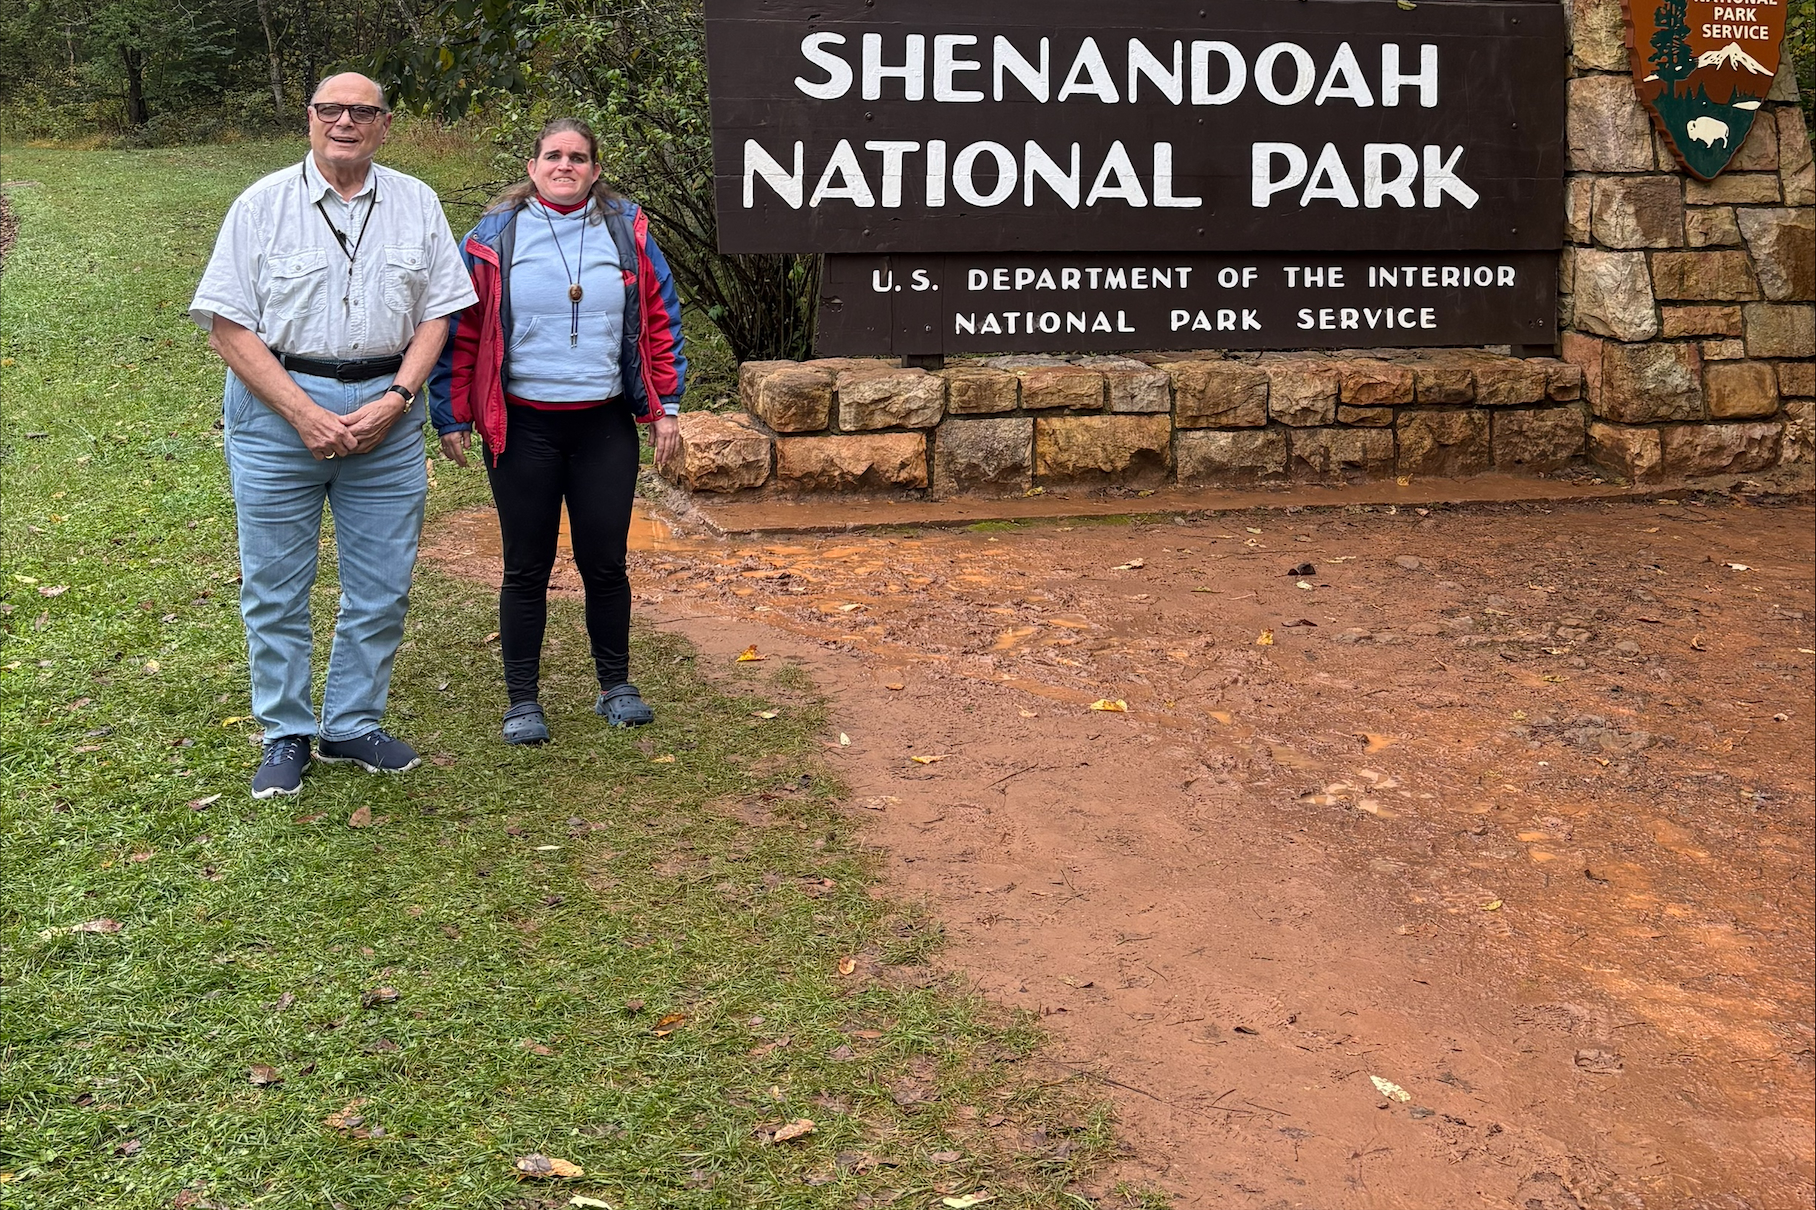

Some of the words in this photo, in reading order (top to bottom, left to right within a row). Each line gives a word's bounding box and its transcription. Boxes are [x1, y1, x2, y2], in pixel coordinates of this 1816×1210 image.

[1715, 7, 1756, 21] PARK
[1703, 24, 1768, 39] SERVICE
[794, 32, 1438, 107] SHENANDOAH
[743, 139, 1202, 209] NATIONAL
[1252, 142, 1479, 209] PARK
[968, 268, 1192, 290] DEPARTMENT
[1218, 267, 1257, 288] OF
[1283, 267, 1344, 287] THE
[1369, 266, 1515, 287] INTERIOR
[956, 311, 1135, 334] NATIONAL
[1171, 309, 1261, 331] PARK
[1297, 308, 1436, 329] SERVICE
